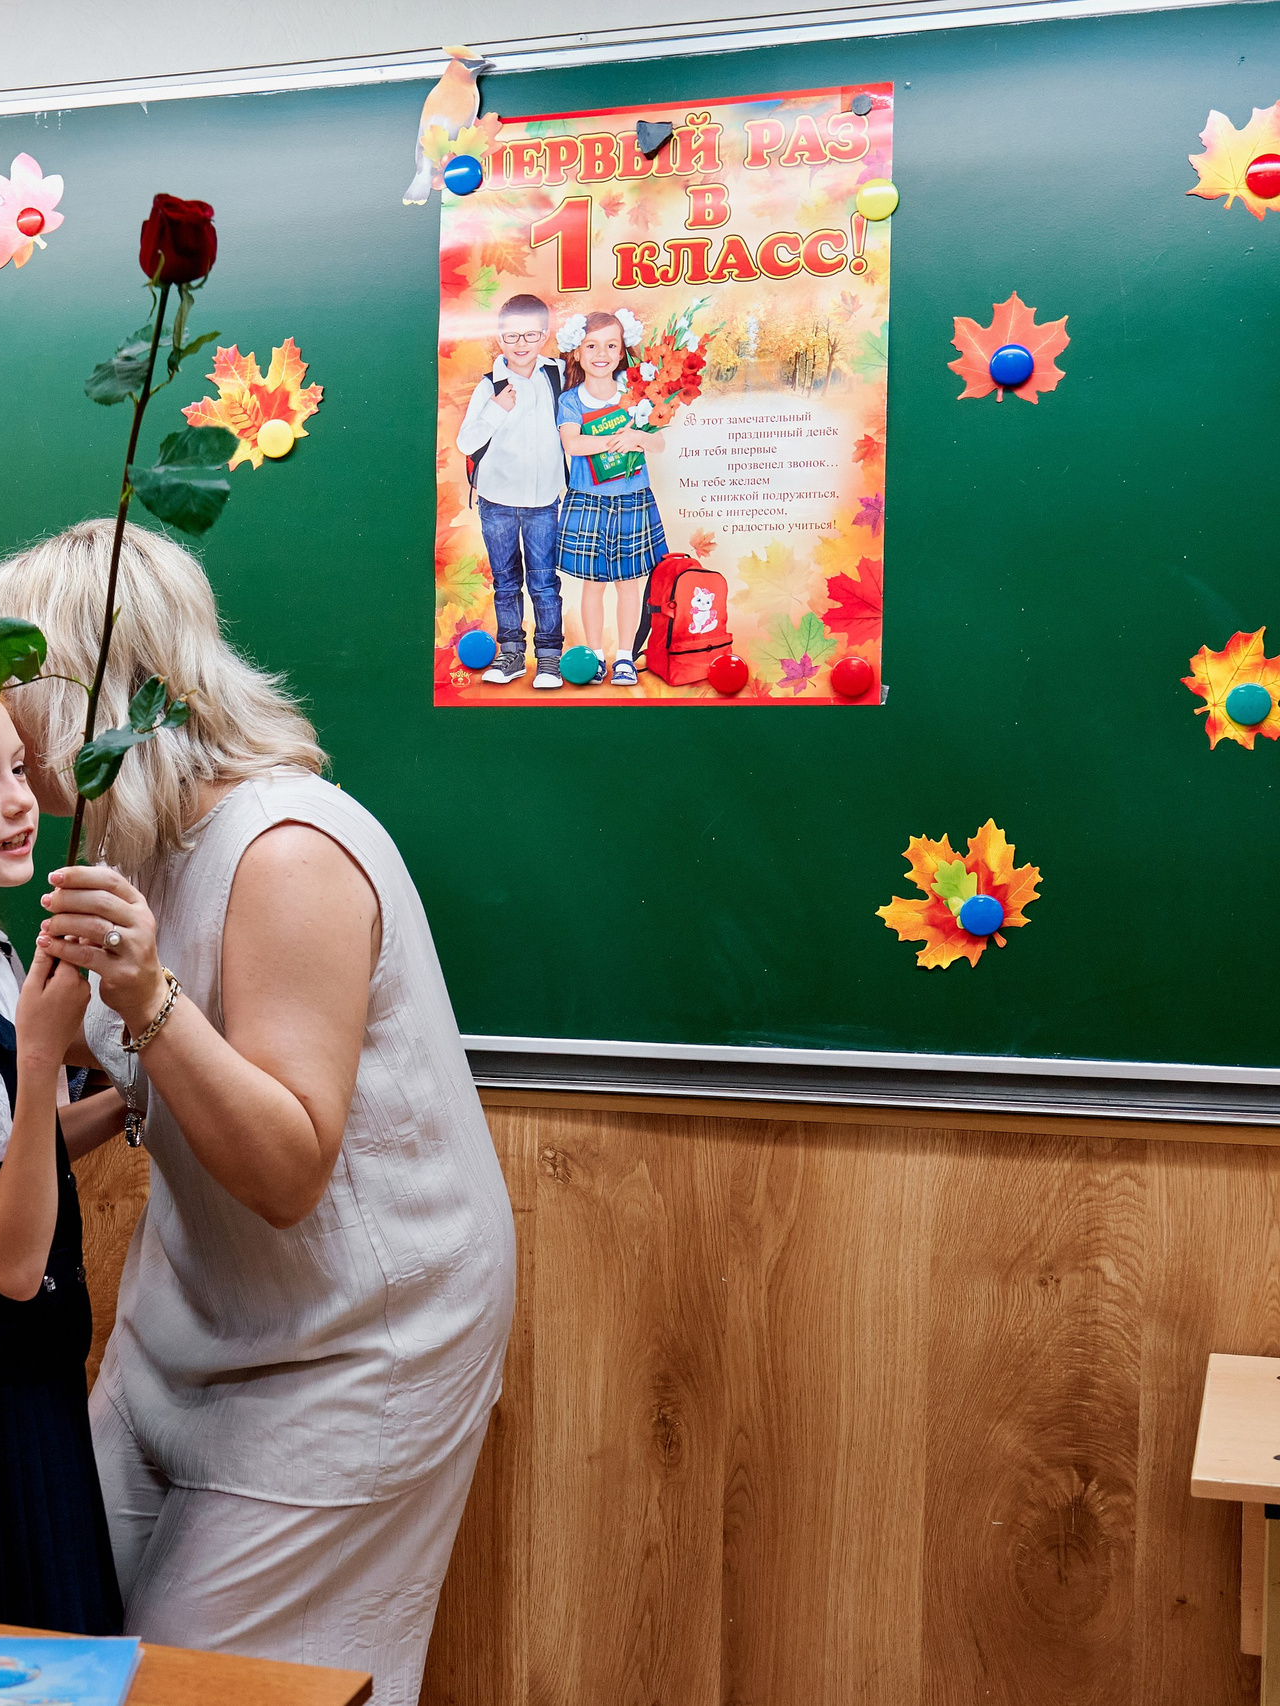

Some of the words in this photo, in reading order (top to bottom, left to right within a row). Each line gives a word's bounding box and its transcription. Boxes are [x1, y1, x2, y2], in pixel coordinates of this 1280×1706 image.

[744, 113, 868, 167] РАЗ
[685, 183, 730, 231] В
[530, 196, 593, 293] 1
[612, 212, 868, 289] КЛАСС!
[683, 413, 697, 426] В
[700, 417, 724, 426] этот
[726, 412, 812, 424] замечательный
[728, 427, 803, 441] праздничный
[806, 427, 839, 437] денёк
[679, 448, 700, 458] Для
[704, 446, 727, 456] тебя
[731, 445, 778, 455] впервые
[727, 461, 784, 471] прозвенел
[679, 478, 699, 488] Мы
[702, 477, 726, 487] тебе
[729, 477, 770, 486] желаем
[701, 494, 707, 502] с
[710, 491, 758, 502] книжкой
[762, 490, 839, 502] подружиться,
[678, 508, 714, 518] Чтобы
[717, 509, 723, 517] с
[726, 507, 788, 518] интересом,
[723, 524, 728, 532] с
[732, 520, 785, 534] радостью
[788, 520, 836, 531] учиться!
